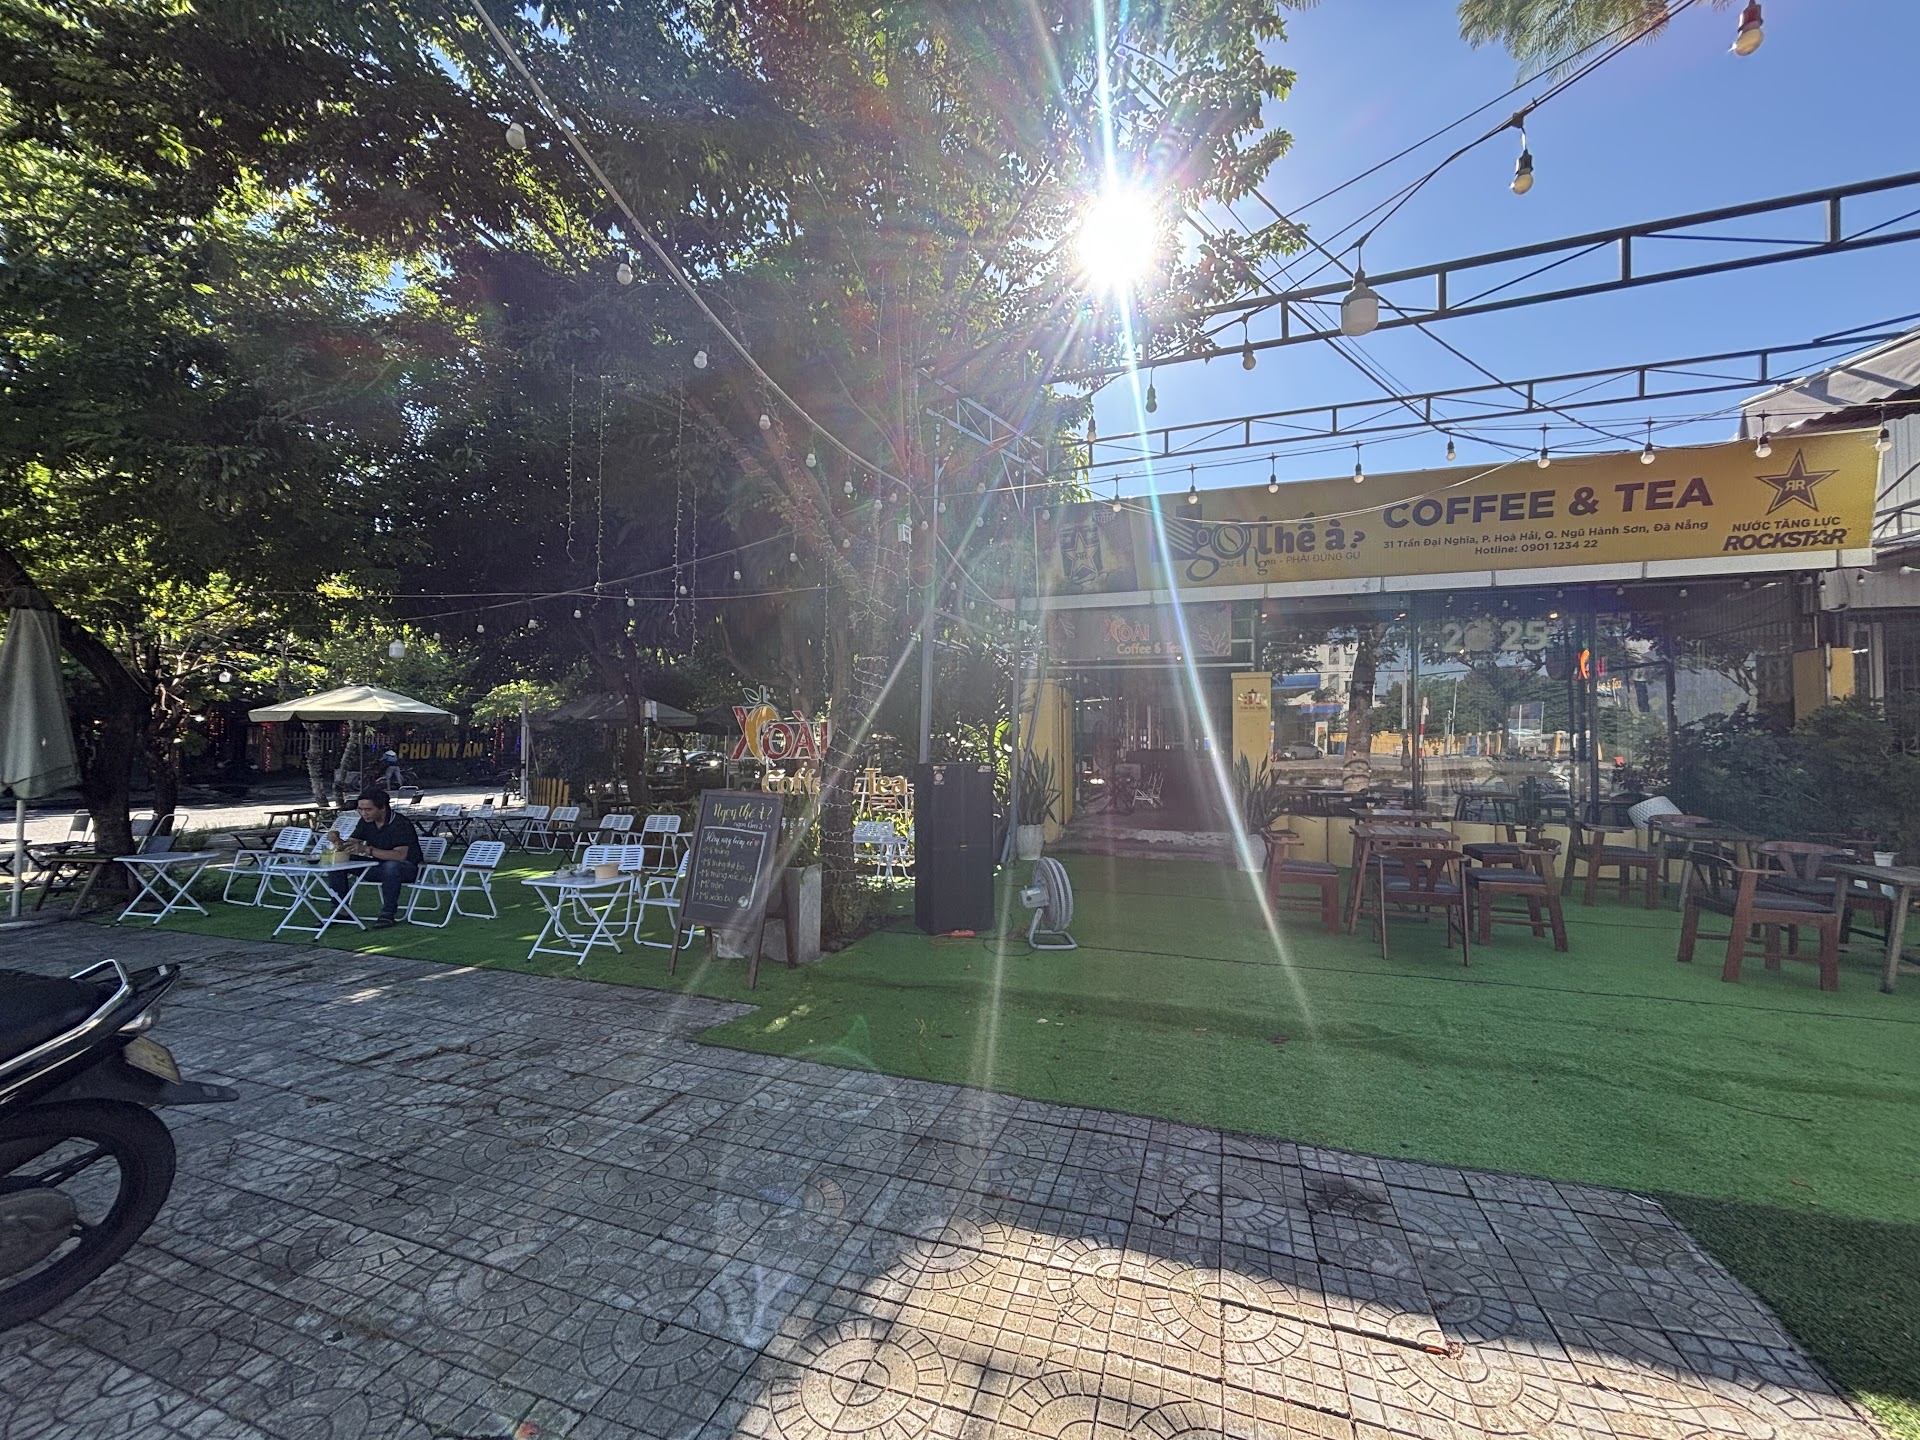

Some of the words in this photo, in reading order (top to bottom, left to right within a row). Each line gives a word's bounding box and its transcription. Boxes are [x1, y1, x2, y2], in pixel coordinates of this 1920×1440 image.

[1383, 489, 1557, 529] COFFEE
[1568, 487, 1600, 516] &
[1614, 478, 1714, 513] TEA
[1383, 541, 1395, 549] 31
[1423, 537, 1441, 547] Đại
[1444, 534, 1479, 547] Nghĩa,
[1482, 535, 1491, 543] P.
[1544, 530, 1557, 539] Q.
[1623, 525, 1649, 535] Sơn,
[1653, 522, 1671, 532] Đà
[1732, 520, 1771, 532] NƯỚC
[1774, 517, 1810, 530] TĂNG
[1813, 516, 1841, 531] LỰC
[1475, 544, 1518, 555] Hotline:
[1521, 542, 1549, 552] 0901
[1552, 540, 1579, 551] 1234
[1583, 539, 1598, 549] 22
[1722, 528, 1848, 551] ROCKSTAR
[1117, 643, 1151, 655] Coffee
[1164, 642, 1182, 654] Tea
[730, 705, 830, 763] XOÀI
[463, 743, 483, 758] AN
[863, 767, 907, 795] Tea
